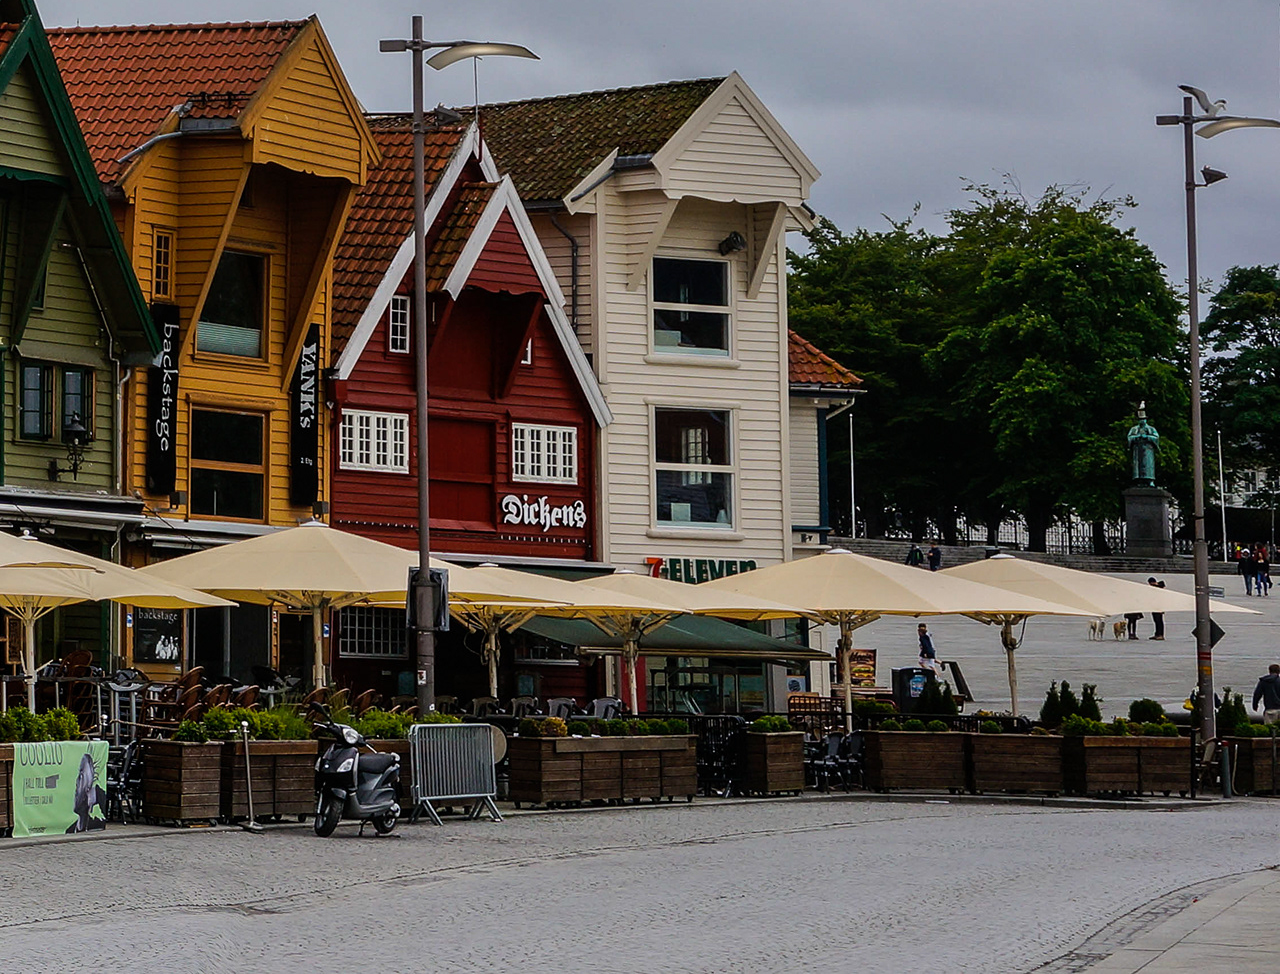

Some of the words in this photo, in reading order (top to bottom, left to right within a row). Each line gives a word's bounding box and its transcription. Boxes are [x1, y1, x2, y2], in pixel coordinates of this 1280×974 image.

[155, 322, 180, 452] backstage
[502, 494, 587, 533] Dickens
[138, 608, 178, 625] backstage
[20, 742, 63, 766] COOLIO
